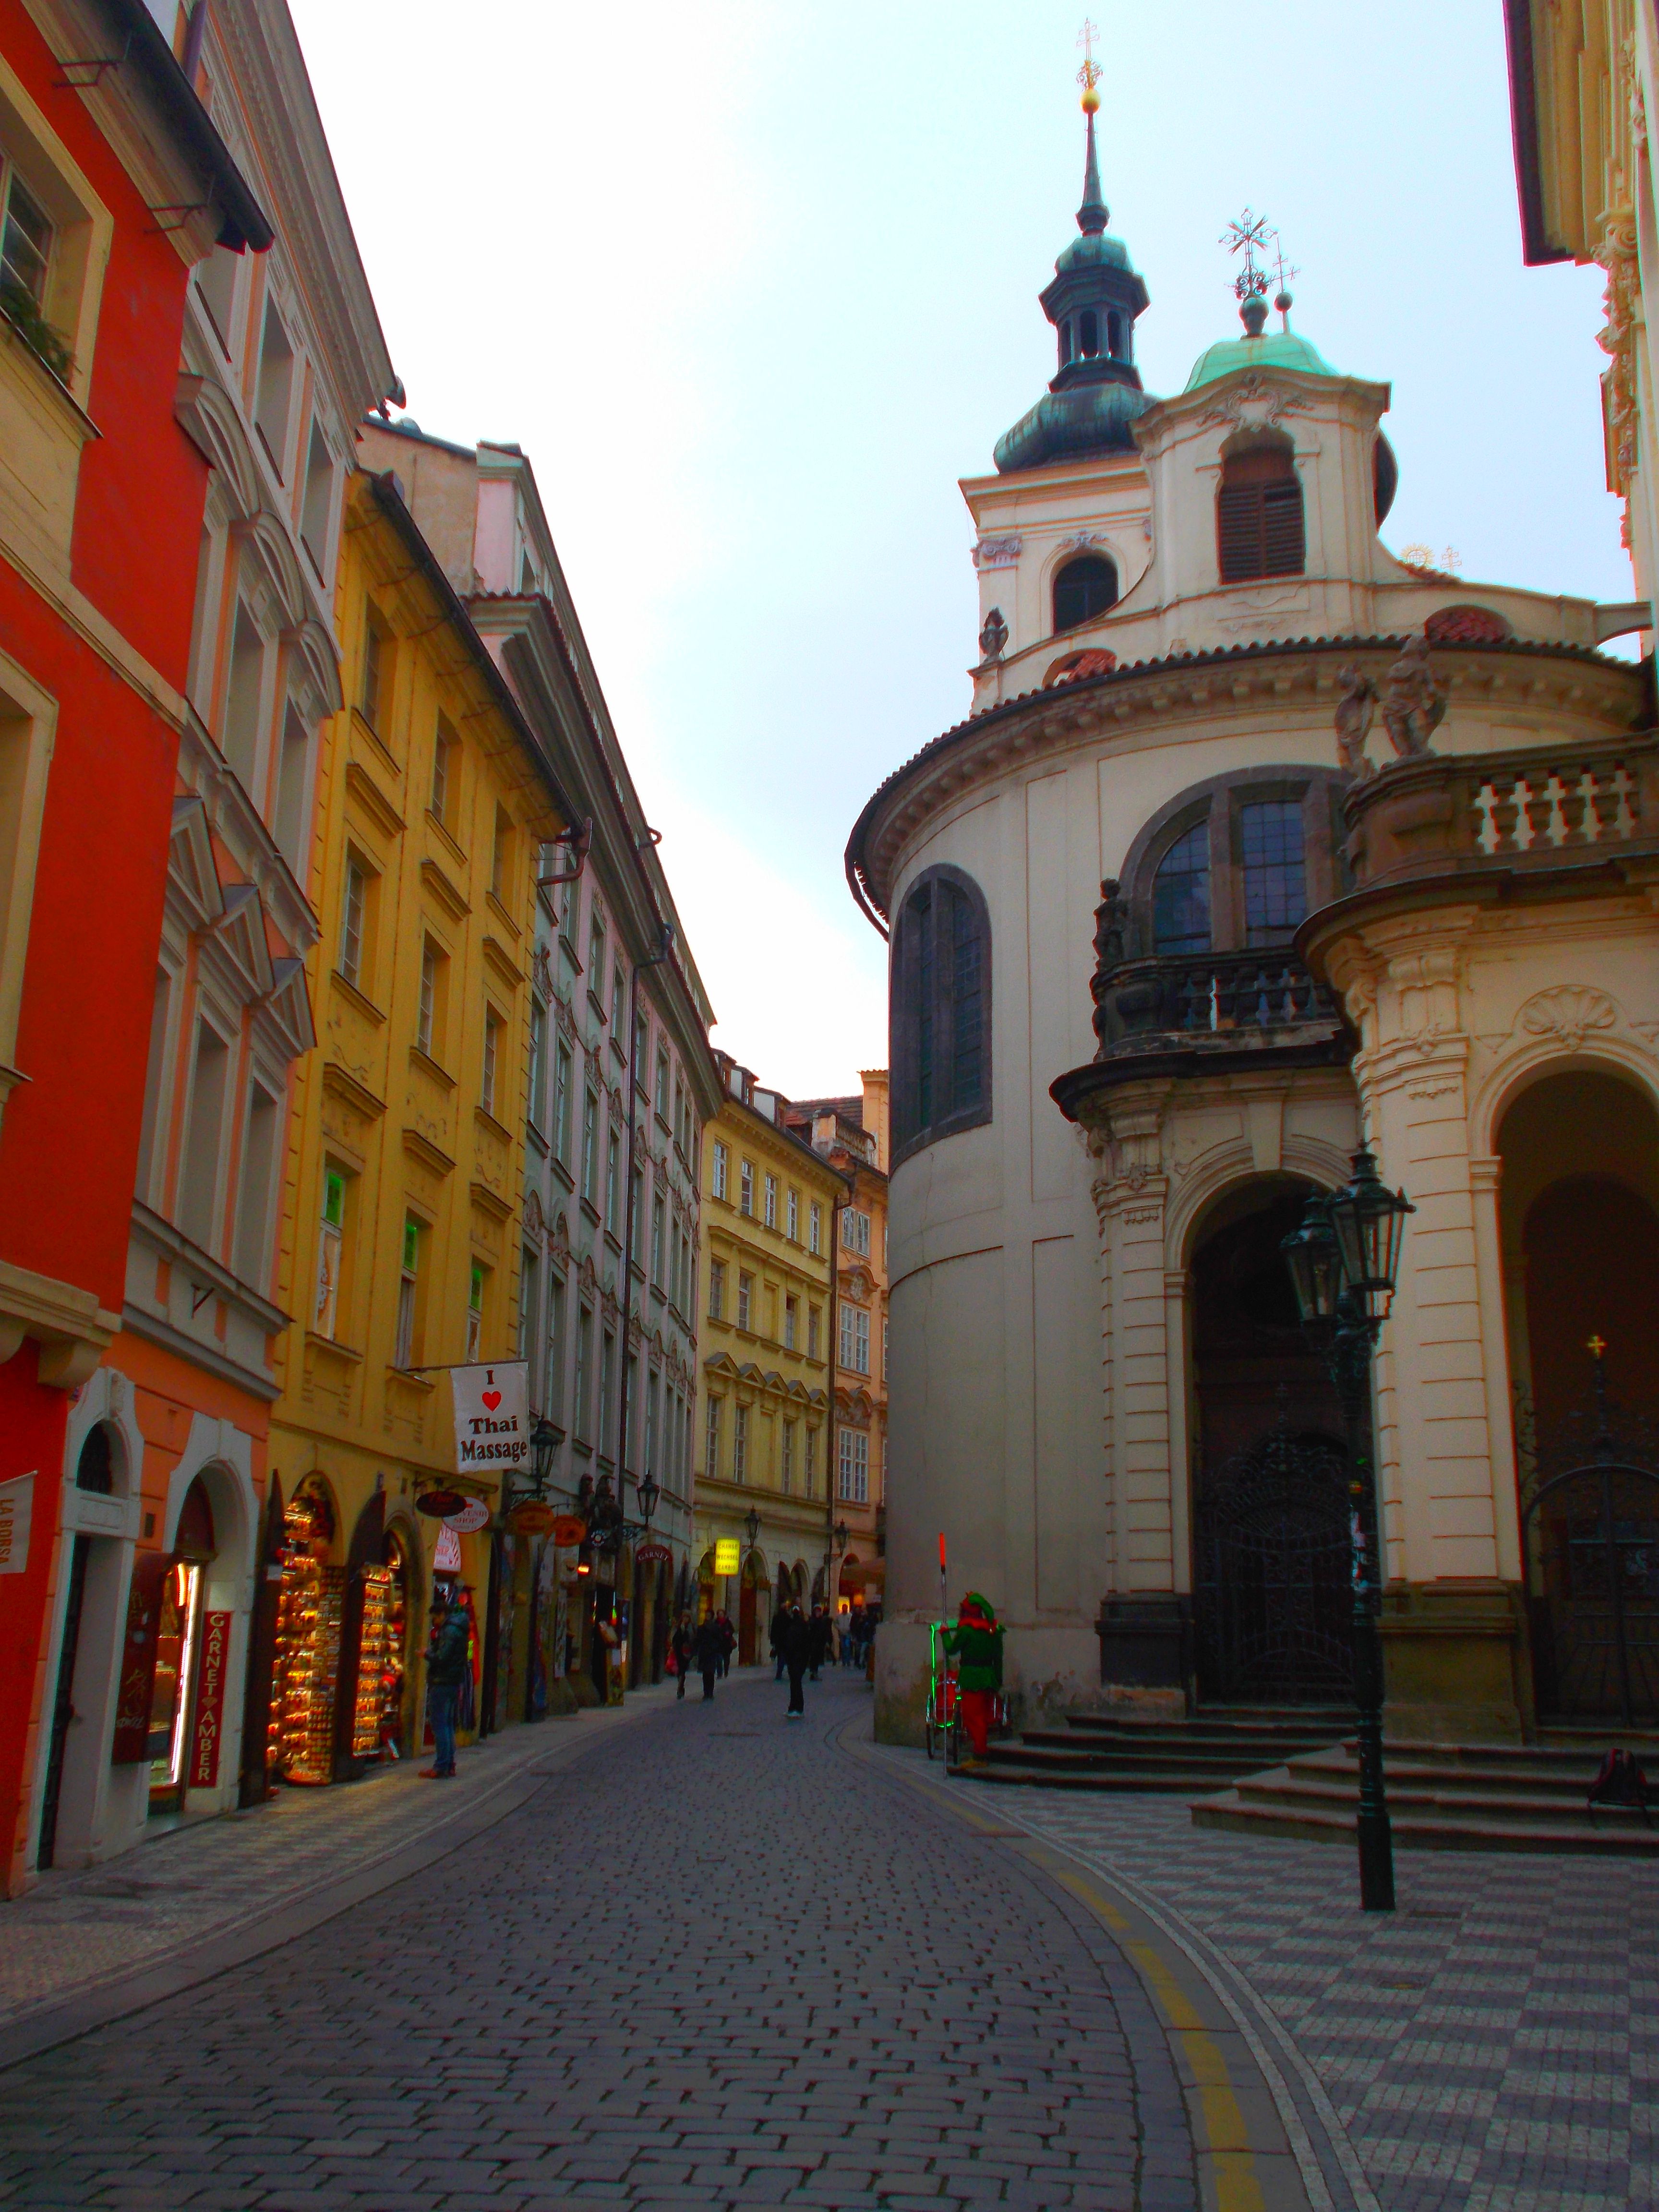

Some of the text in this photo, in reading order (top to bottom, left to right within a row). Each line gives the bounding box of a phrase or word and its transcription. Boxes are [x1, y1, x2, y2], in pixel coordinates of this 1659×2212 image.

[486, 1370, 495, 1385] I
[469, 1415, 519, 1434] Thai
[460, 1440, 528, 1463] Massage
[638, 1551, 669, 1561] GARNET
[204, 1613, 225, 1695] GARNET
[198, 1710, 216, 1781] AMBER
